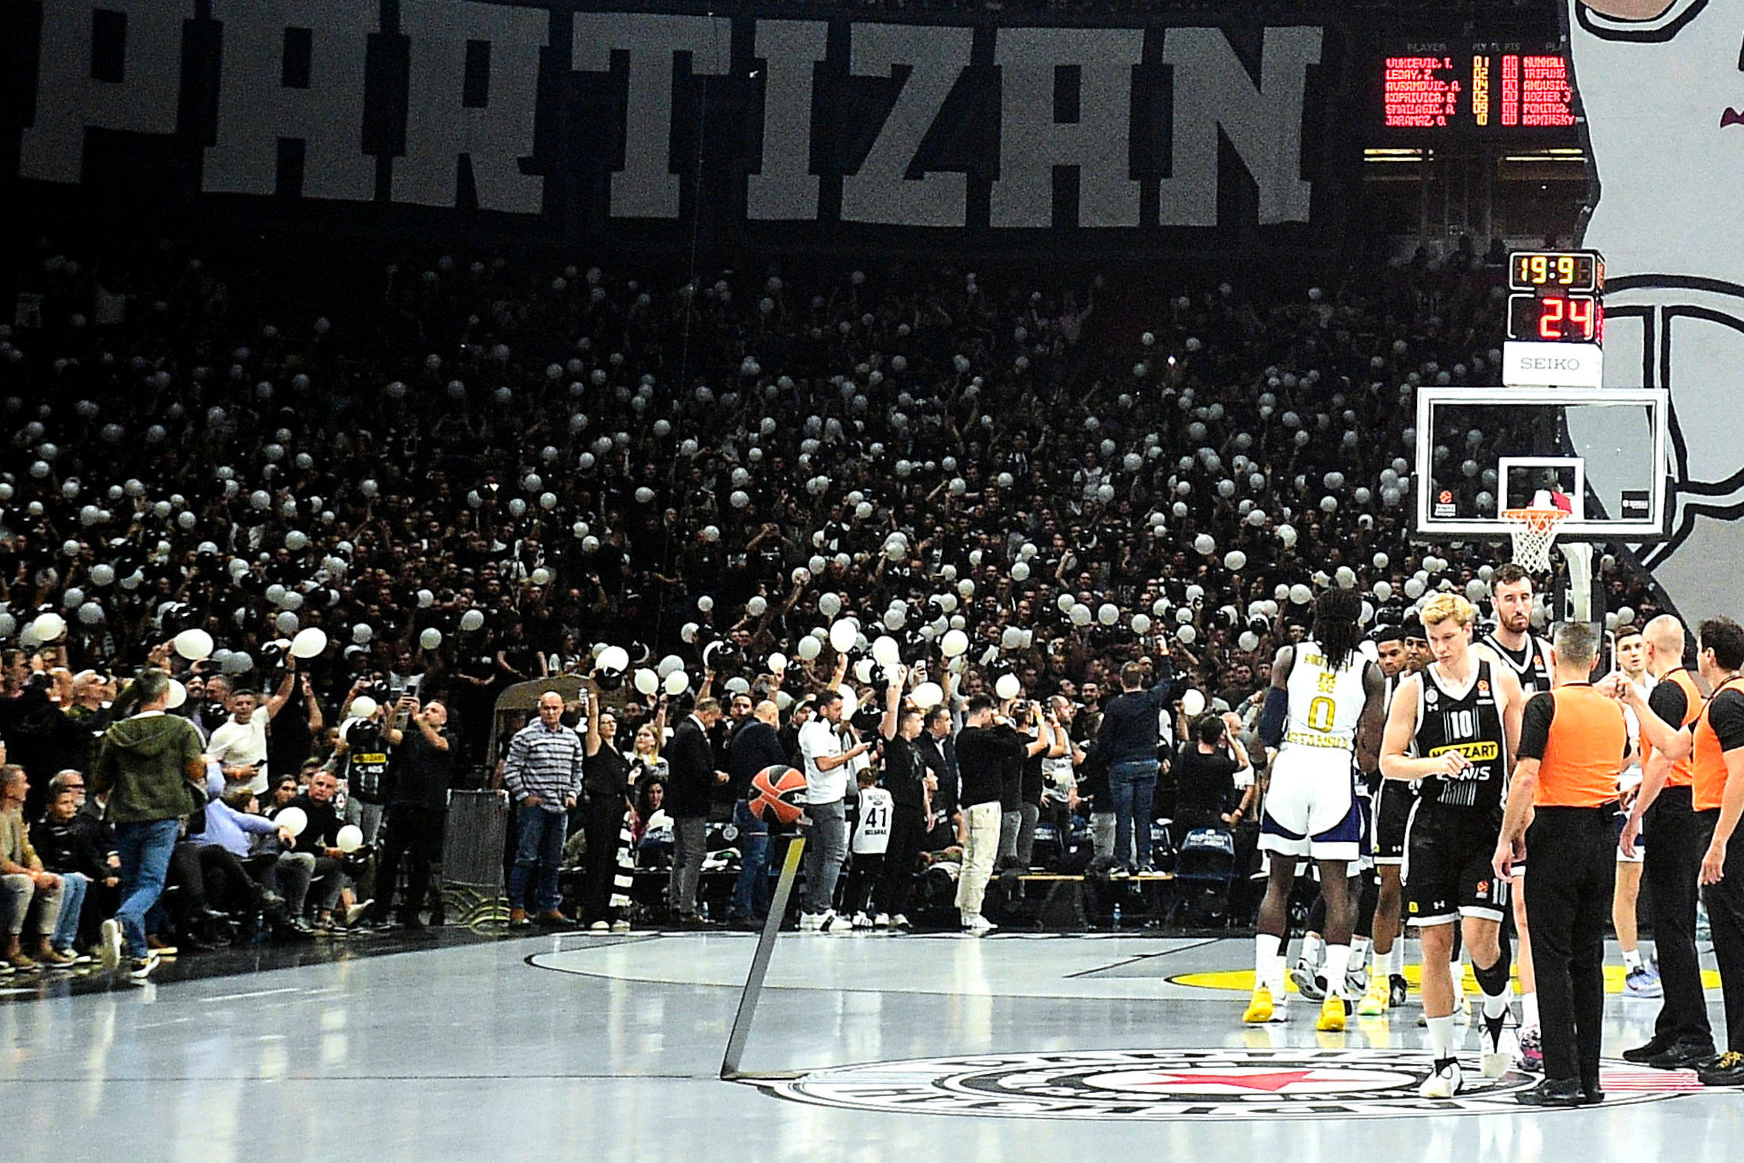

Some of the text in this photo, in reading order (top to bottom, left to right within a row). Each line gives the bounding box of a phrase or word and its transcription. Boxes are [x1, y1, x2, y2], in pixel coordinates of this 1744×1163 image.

[1473, 55, 1489, 67] 01
[1472, 67, 1489, 79] 02
[1472, 79, 1489, 91] 04
[1472, 91, 1489, 102] 05
[1472, 102, 1489, 114] 09
[1477, 113, 1488, 126] 10
[1540, 298, 1592, 338] 24
[1520, 357, 1580, 370] SEIKO
[1308, 696, 1335, 734] 0
[1450, 710, 1473, 739] 10
[1431, 744, 1496, 759] MZART
[865, 807, 887, 828] 41
